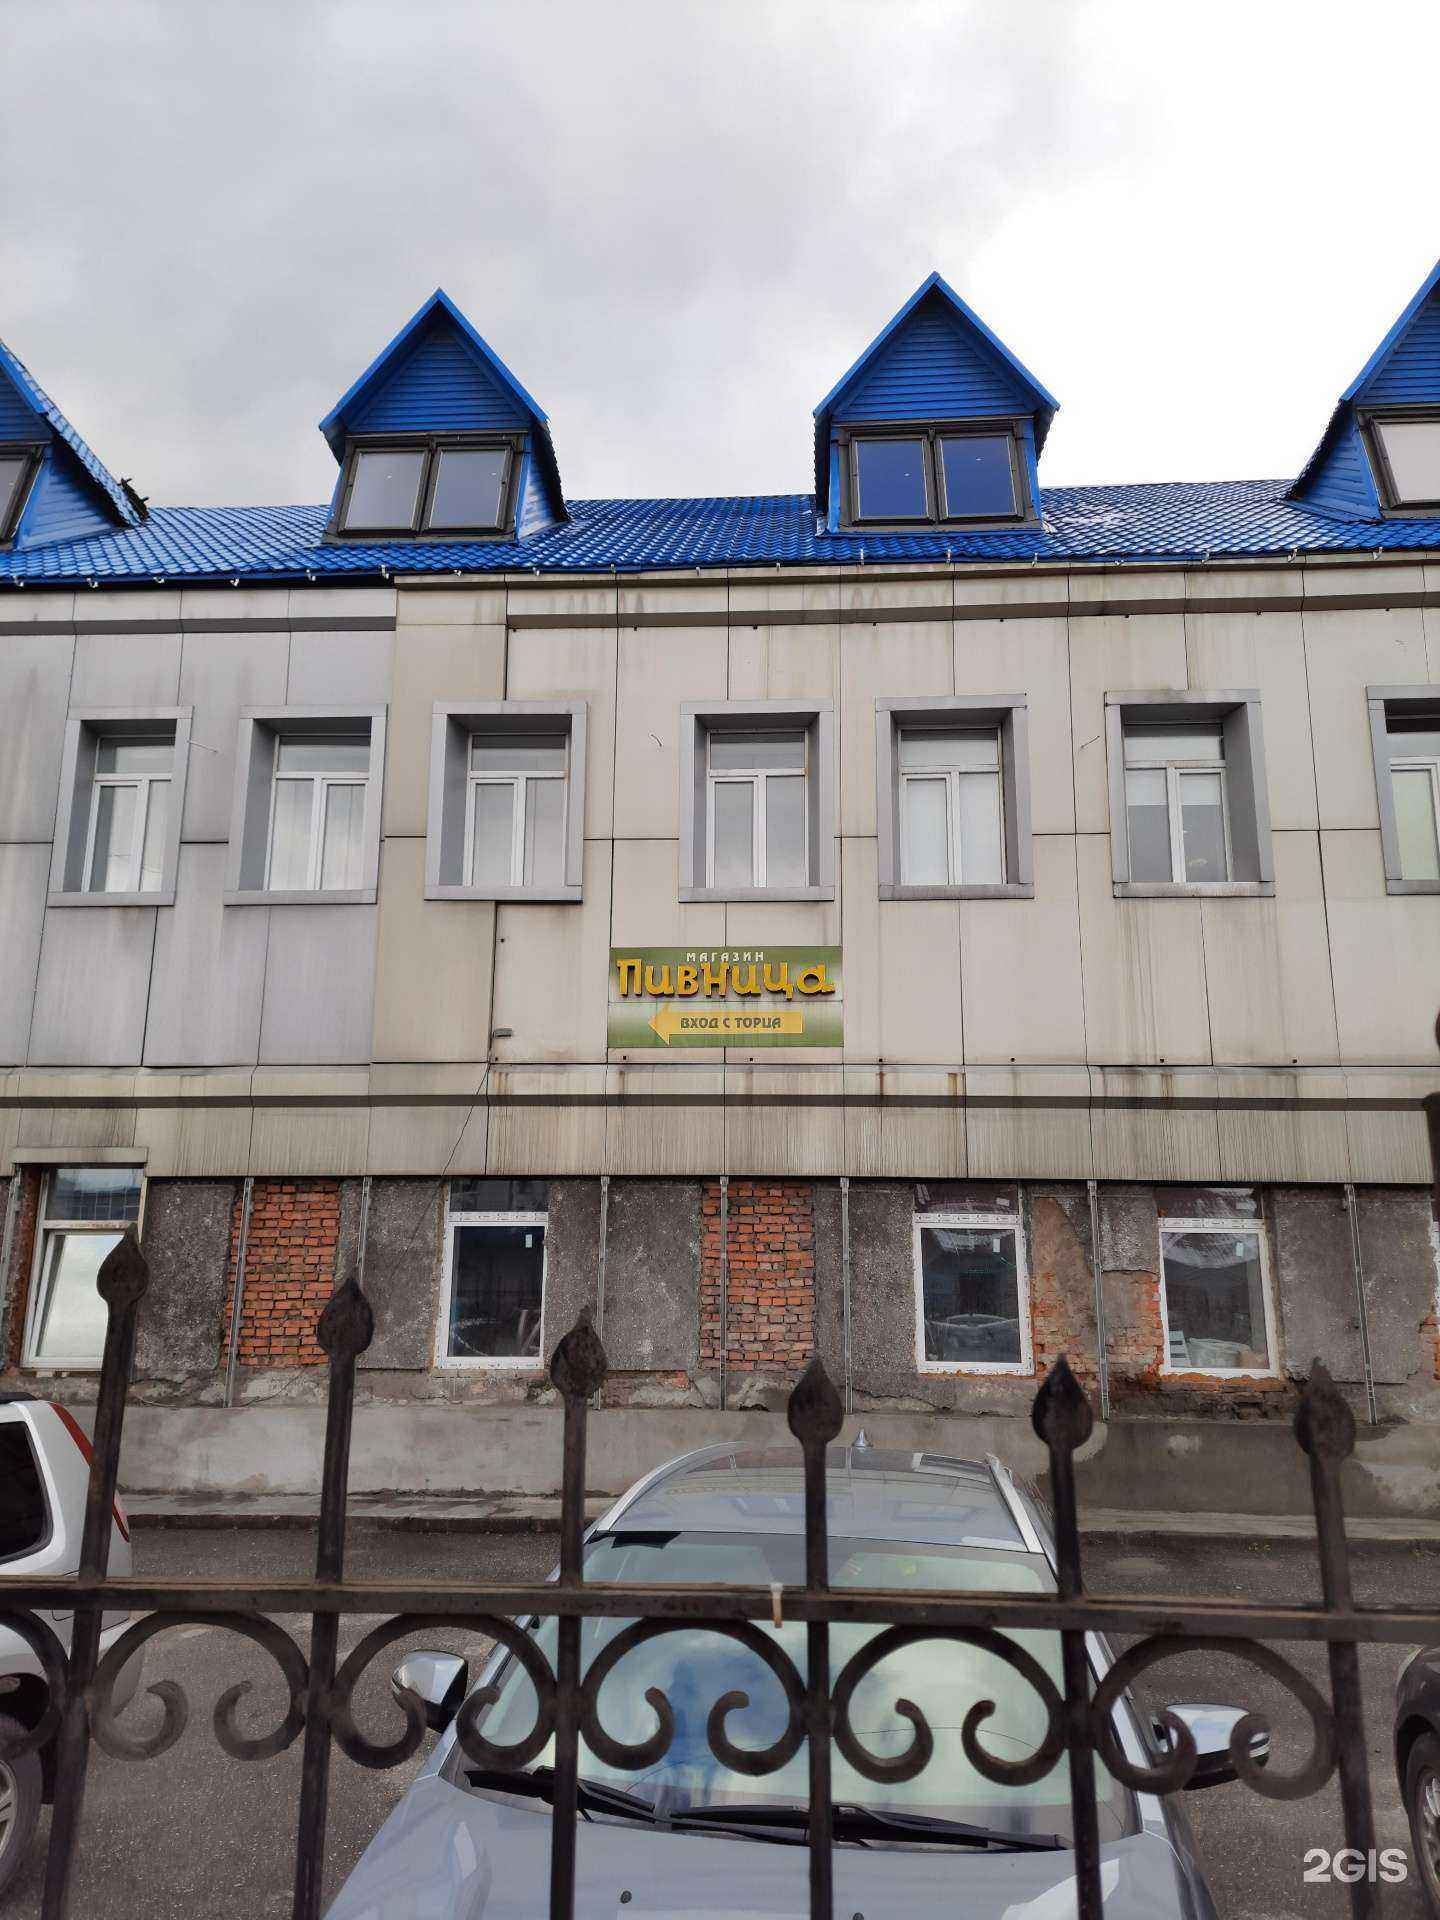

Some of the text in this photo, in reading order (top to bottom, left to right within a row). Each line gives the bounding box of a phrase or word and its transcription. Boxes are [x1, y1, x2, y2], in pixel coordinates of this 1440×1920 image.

[686, 951, 764, 963] МАГАЗИН
[680, 1017, 781, 1029] ВХОД С ТОРЦА
